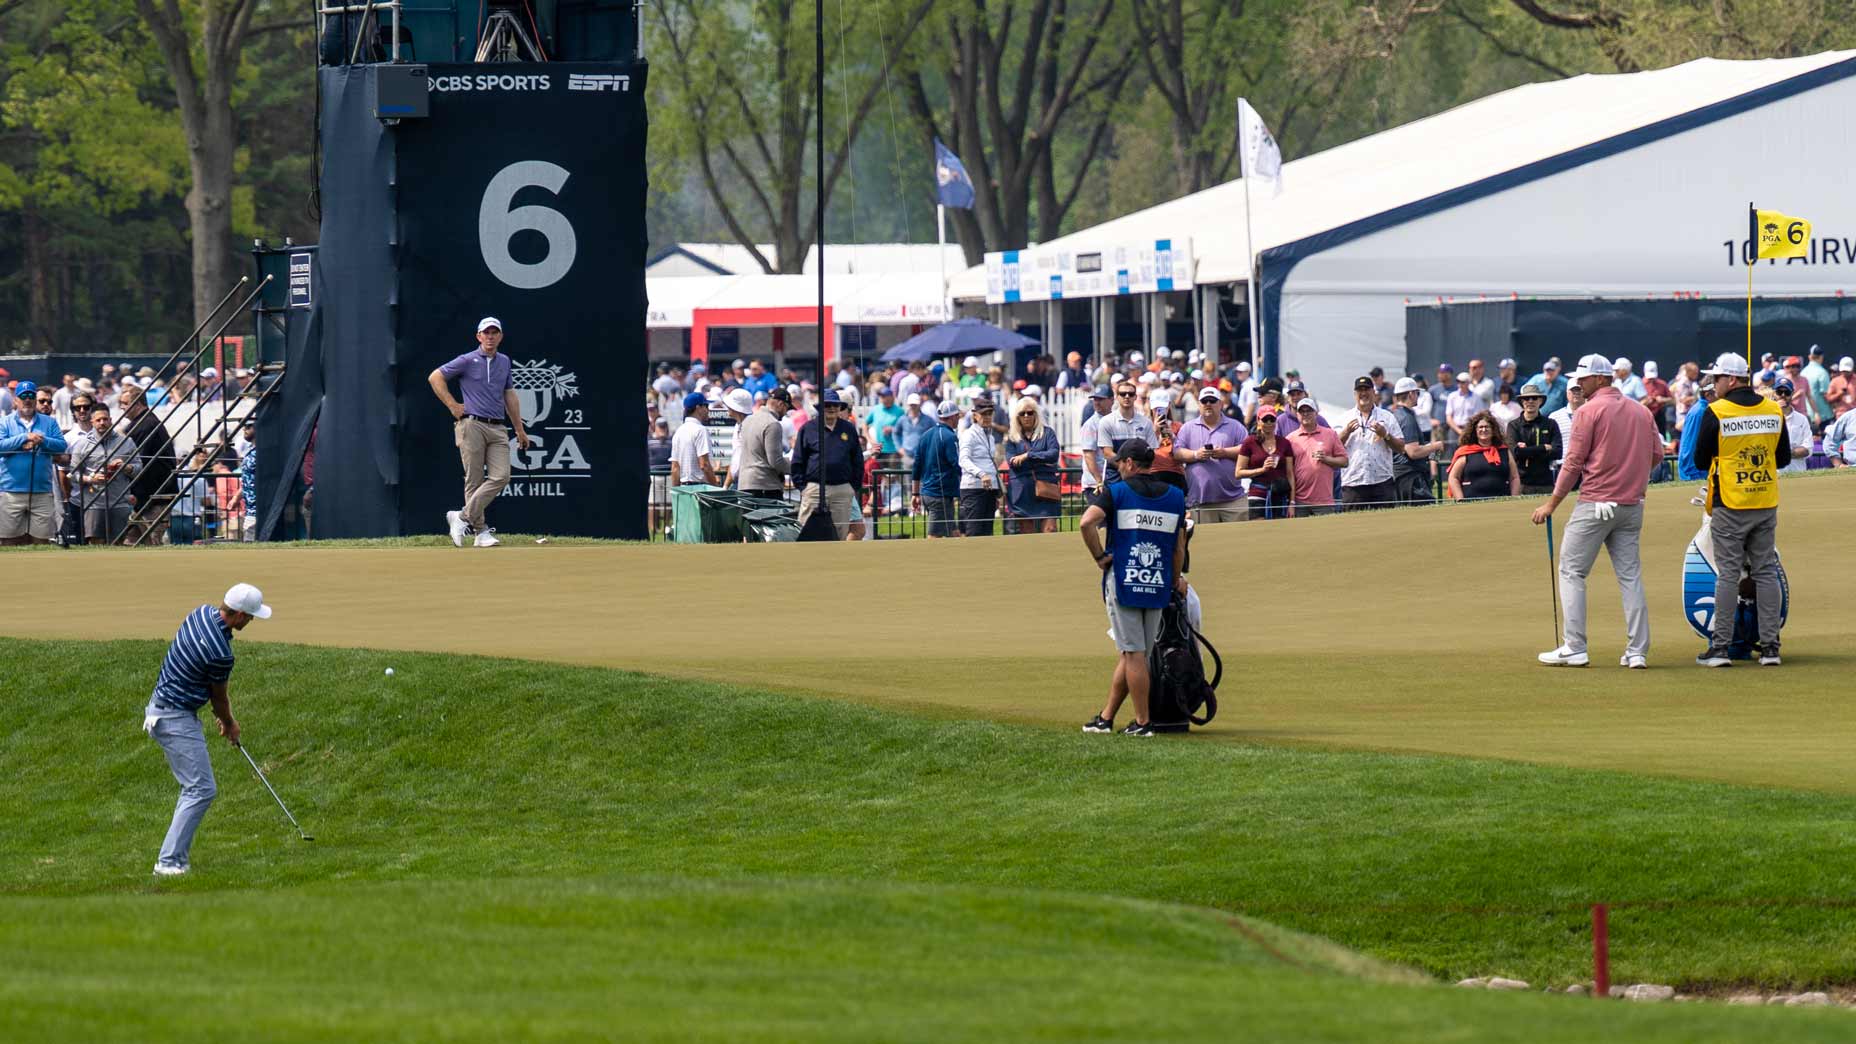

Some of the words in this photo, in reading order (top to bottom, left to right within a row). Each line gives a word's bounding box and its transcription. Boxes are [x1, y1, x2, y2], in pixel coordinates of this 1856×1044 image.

[435, 76, 473, 92] CBS
[475, 75, 550, 91] SPORTS
[568, 73, 630, 91] ESPN
[478, 160, 577, 290] 6
[1787, 221, 1804, 245] 6
[1762, 234, 1782, 243] PGA
[564, 409, 583, 424] 23
[1723, 419, 1779, 432] MONTGOMERY
[508, 433, 591, 471] GA
[1735, 469, 1773, 485] PGA
[497, 482, 524, 497] AK
[529, 482, 565, 497] HILL
[1136, 514, 1163, 527] DAVIS
[1123, 568, 1165, 585] PGA
